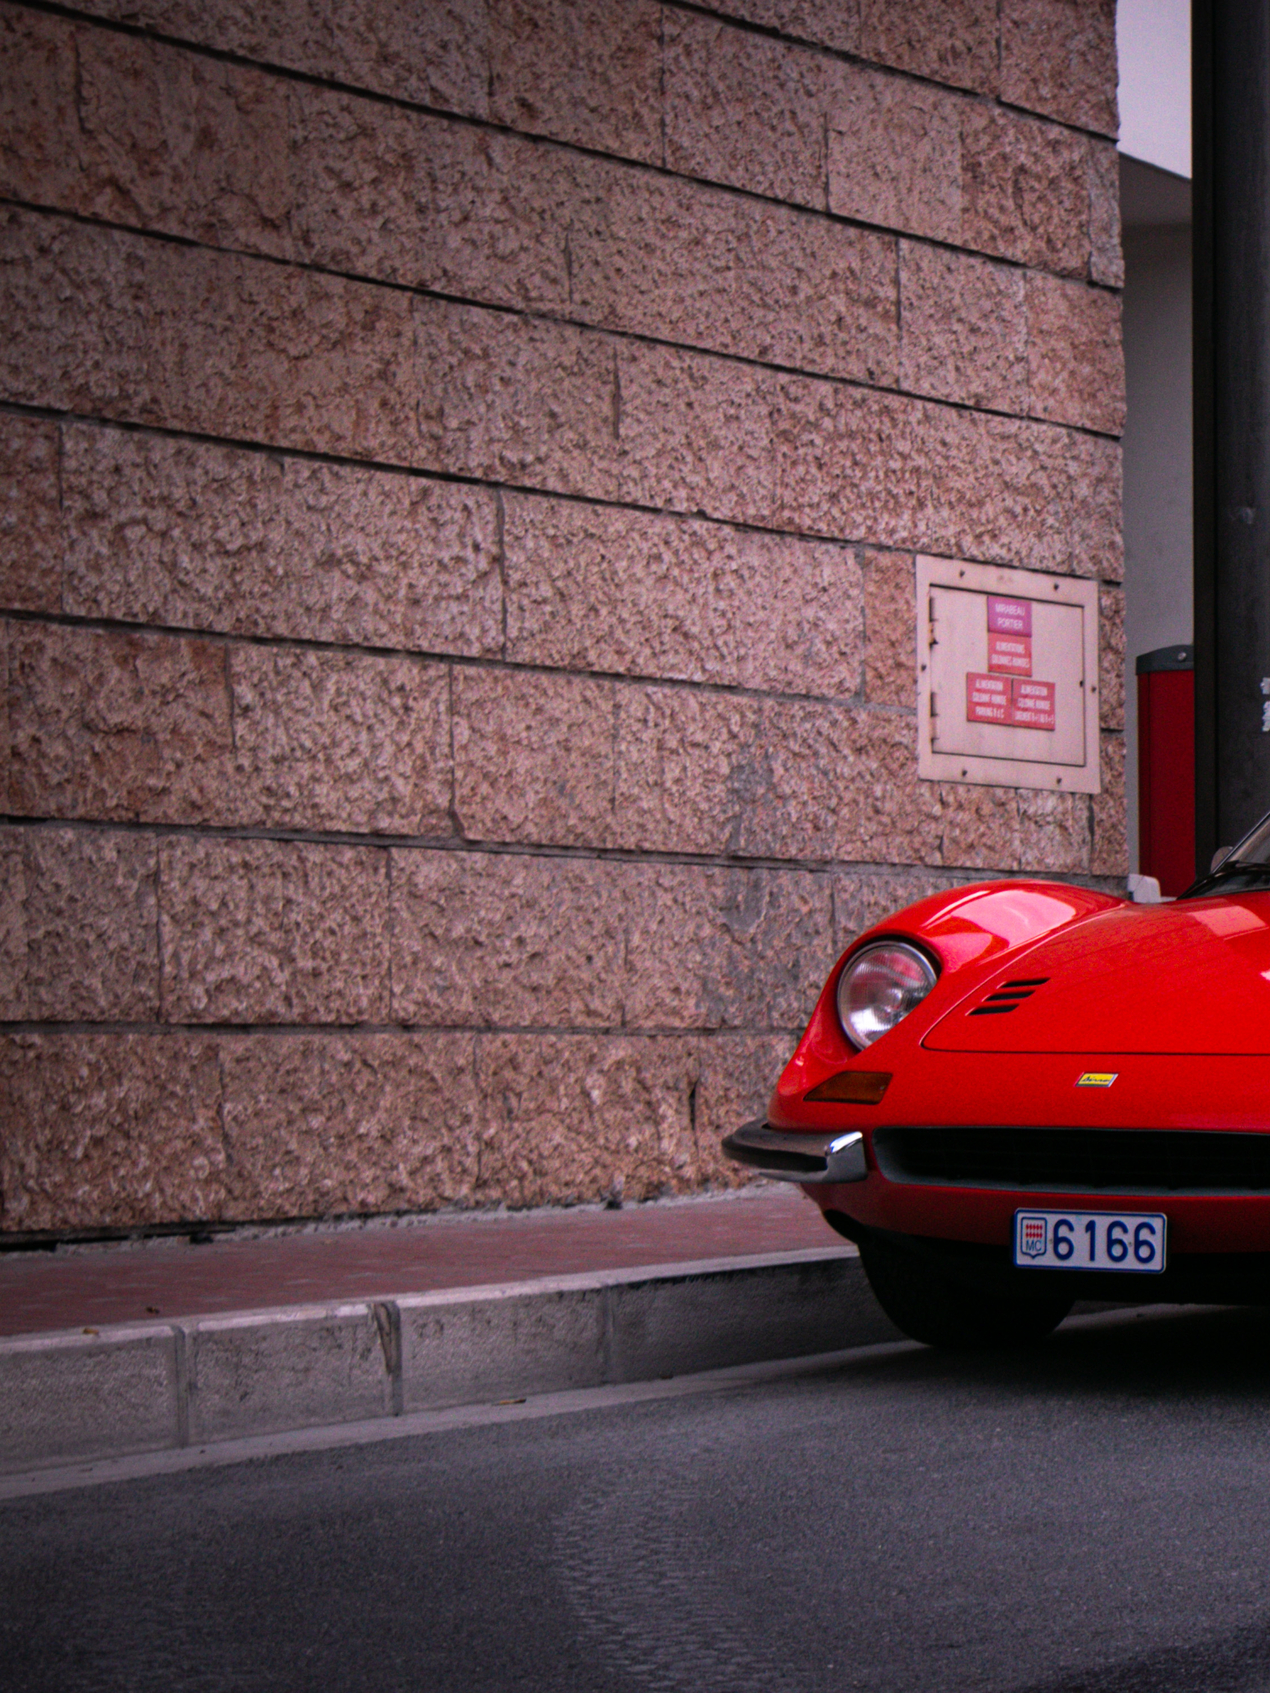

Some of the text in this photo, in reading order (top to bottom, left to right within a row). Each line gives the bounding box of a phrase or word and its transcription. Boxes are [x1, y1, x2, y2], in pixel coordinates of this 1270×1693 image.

[995, 603, 1025, 616] MIRABEAU
[997, 617, 1023, 631] PORTIER
[1025, 1240, 1042, 1251] MC
[1053, 1218, 1156, 1264] 6166
